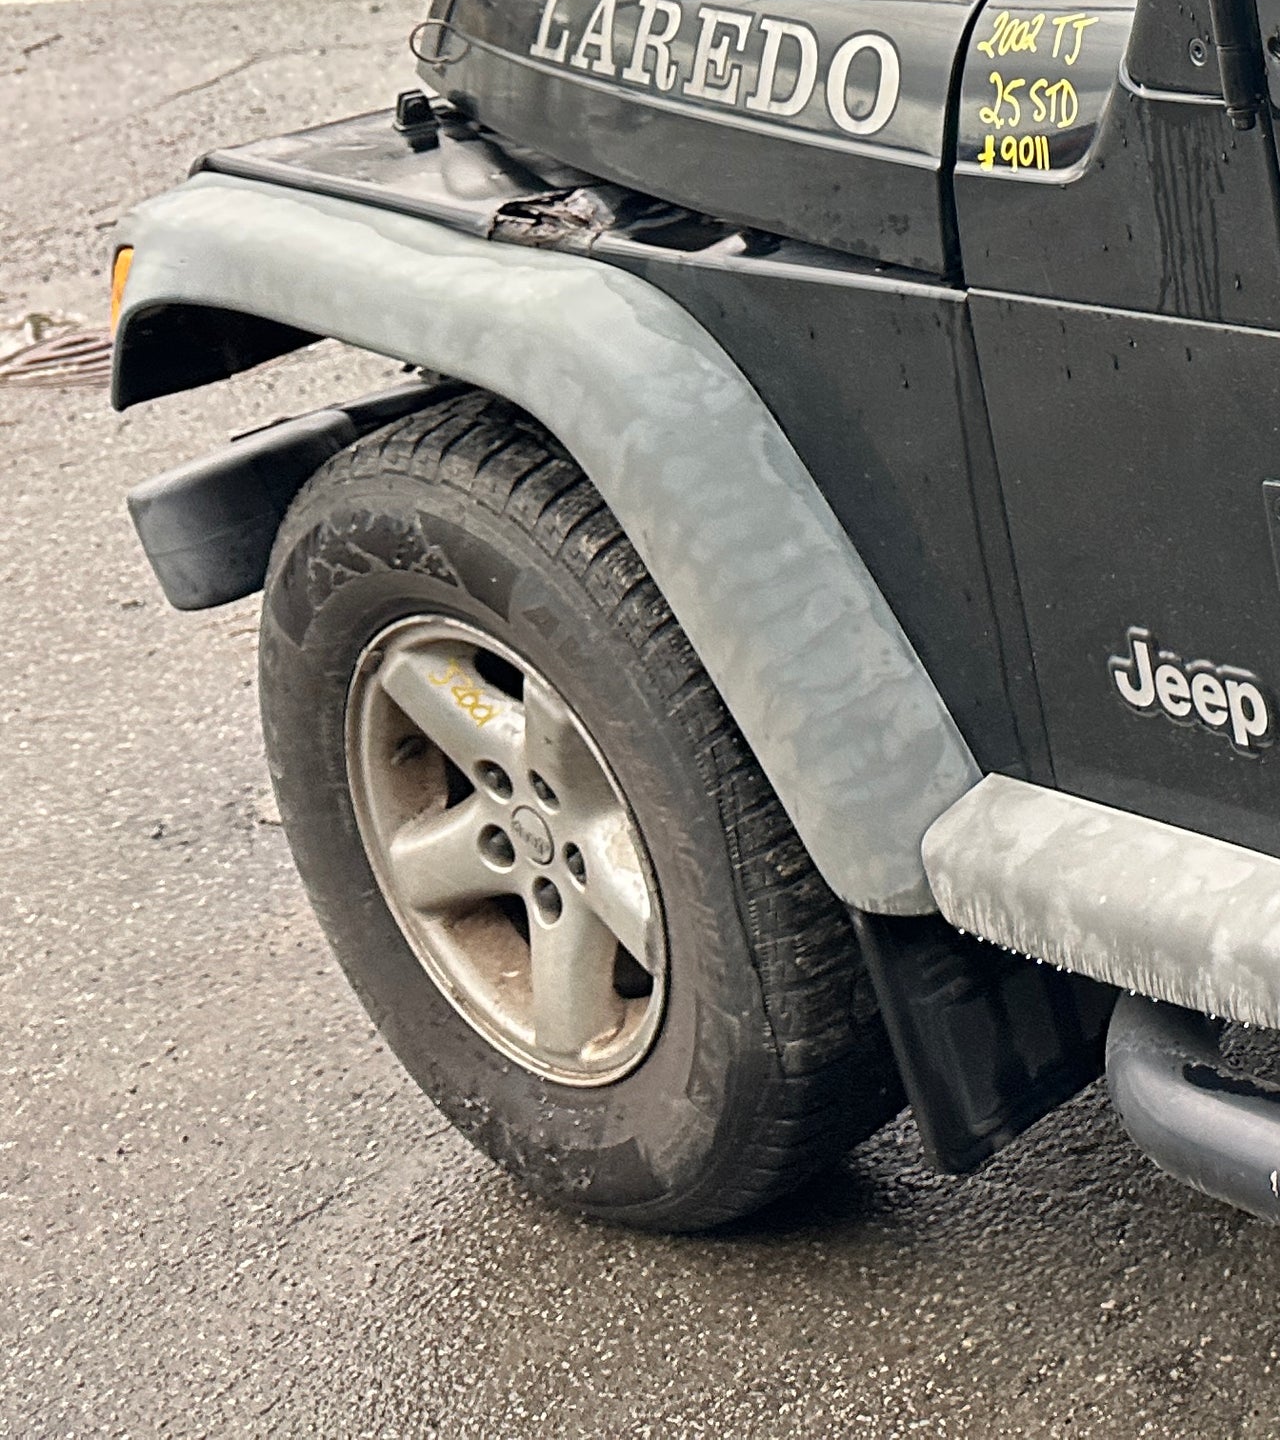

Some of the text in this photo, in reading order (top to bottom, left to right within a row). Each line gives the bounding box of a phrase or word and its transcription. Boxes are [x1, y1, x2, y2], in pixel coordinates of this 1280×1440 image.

[977, 10, 1100, 66] 2002 TJ
[1029, 78, 1079, 129] STD
[977, 134, 1050, 173] #9011
[1113, 639, 1269, 747] Jeep
